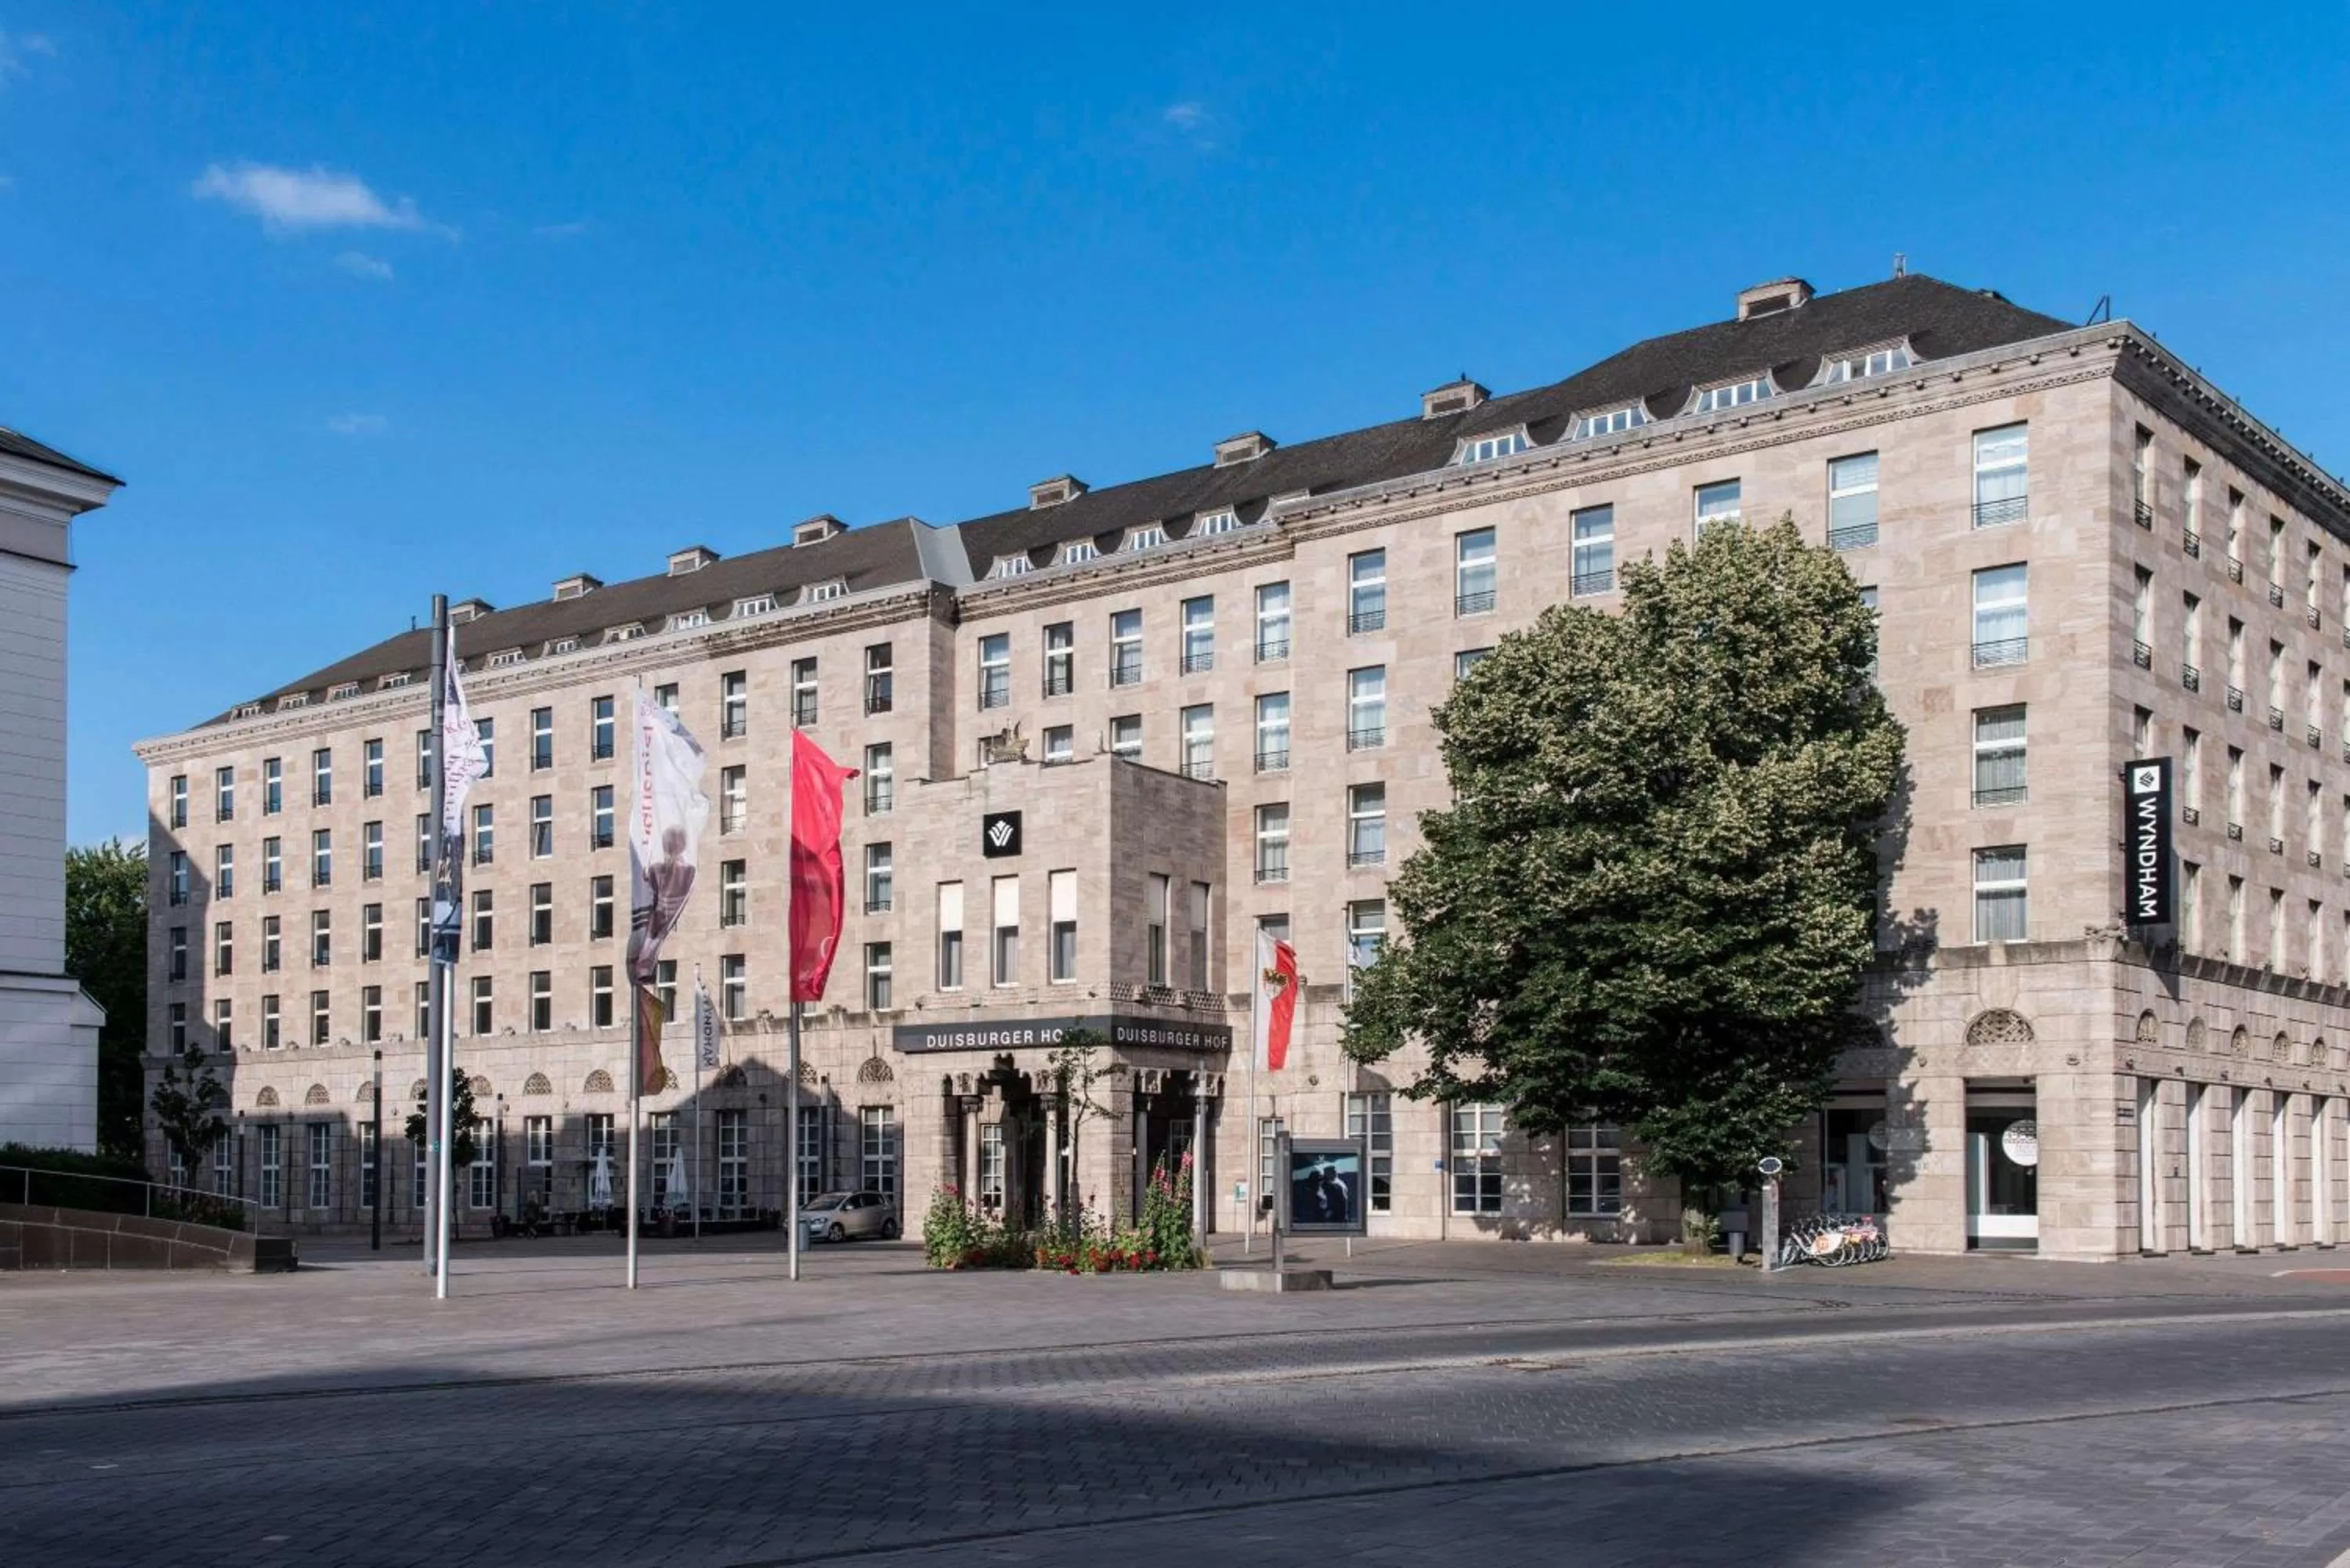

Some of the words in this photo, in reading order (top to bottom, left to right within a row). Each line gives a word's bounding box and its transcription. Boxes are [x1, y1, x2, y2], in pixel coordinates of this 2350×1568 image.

[2138, 797, 2157, 917] WYNDHAM
[927, 1030, 1033, 1048] DUISBURGER
[1041, 1028, 1065, 1043] HO
[1117, 1027, 1199, 1047] DUISBURGER
[1204, 1035, 1229, 1049] HOF
